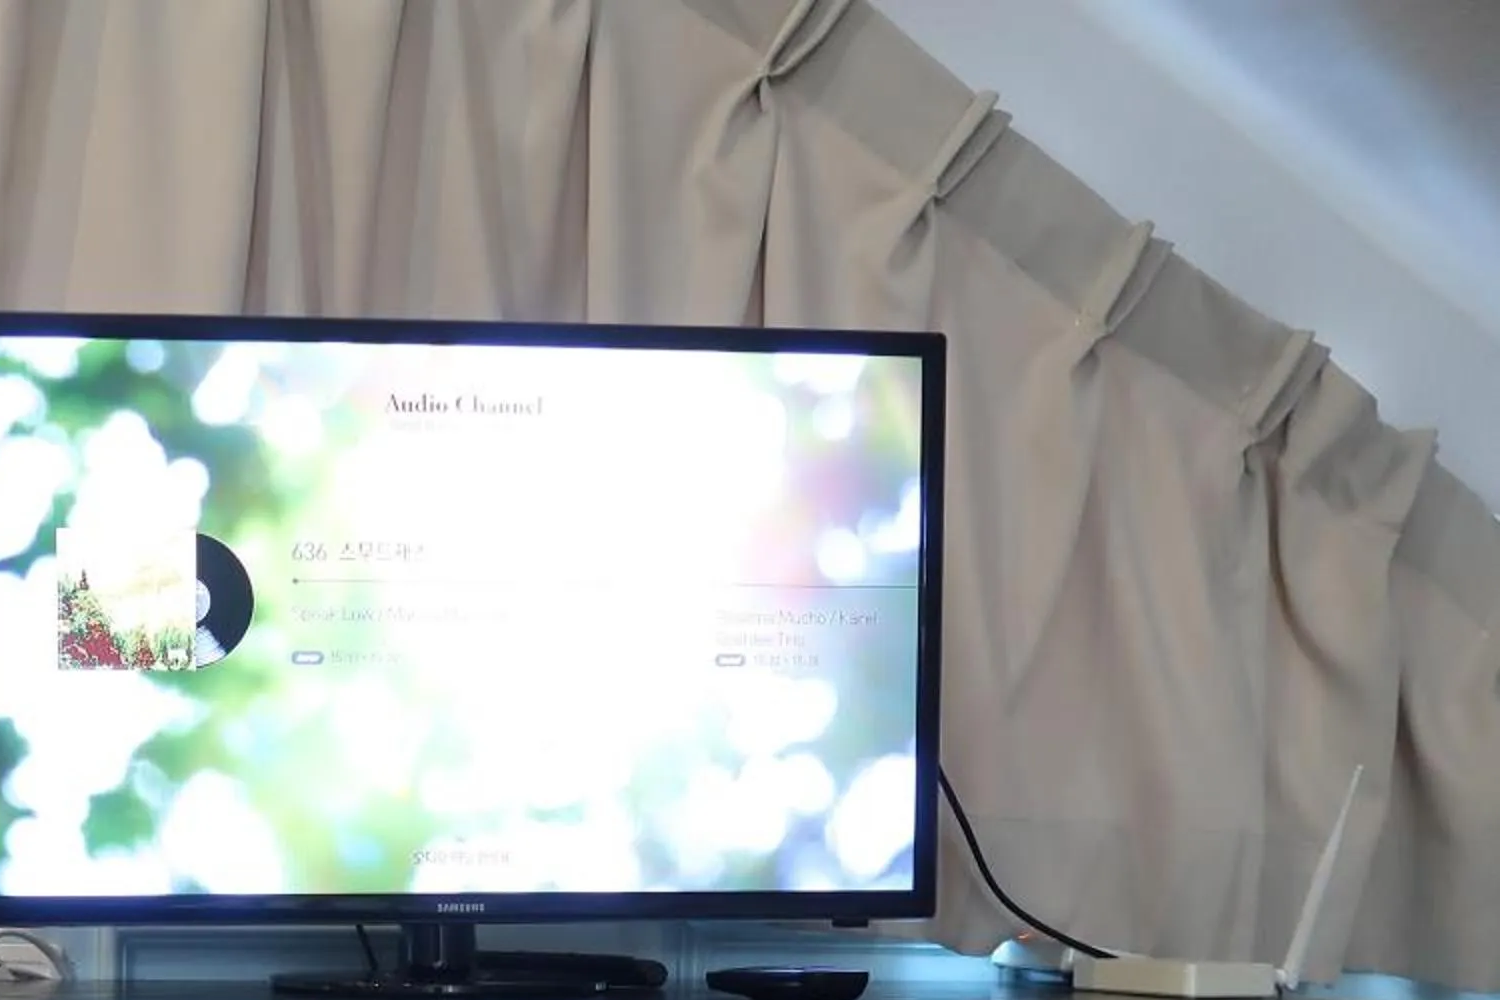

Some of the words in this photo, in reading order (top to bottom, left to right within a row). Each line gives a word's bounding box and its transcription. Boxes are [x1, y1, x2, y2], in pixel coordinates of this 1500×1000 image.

[384, 391, 449, 415] Audio
[454, 393, 545, 417] Channel
[290, 541, 328, 563] 636
